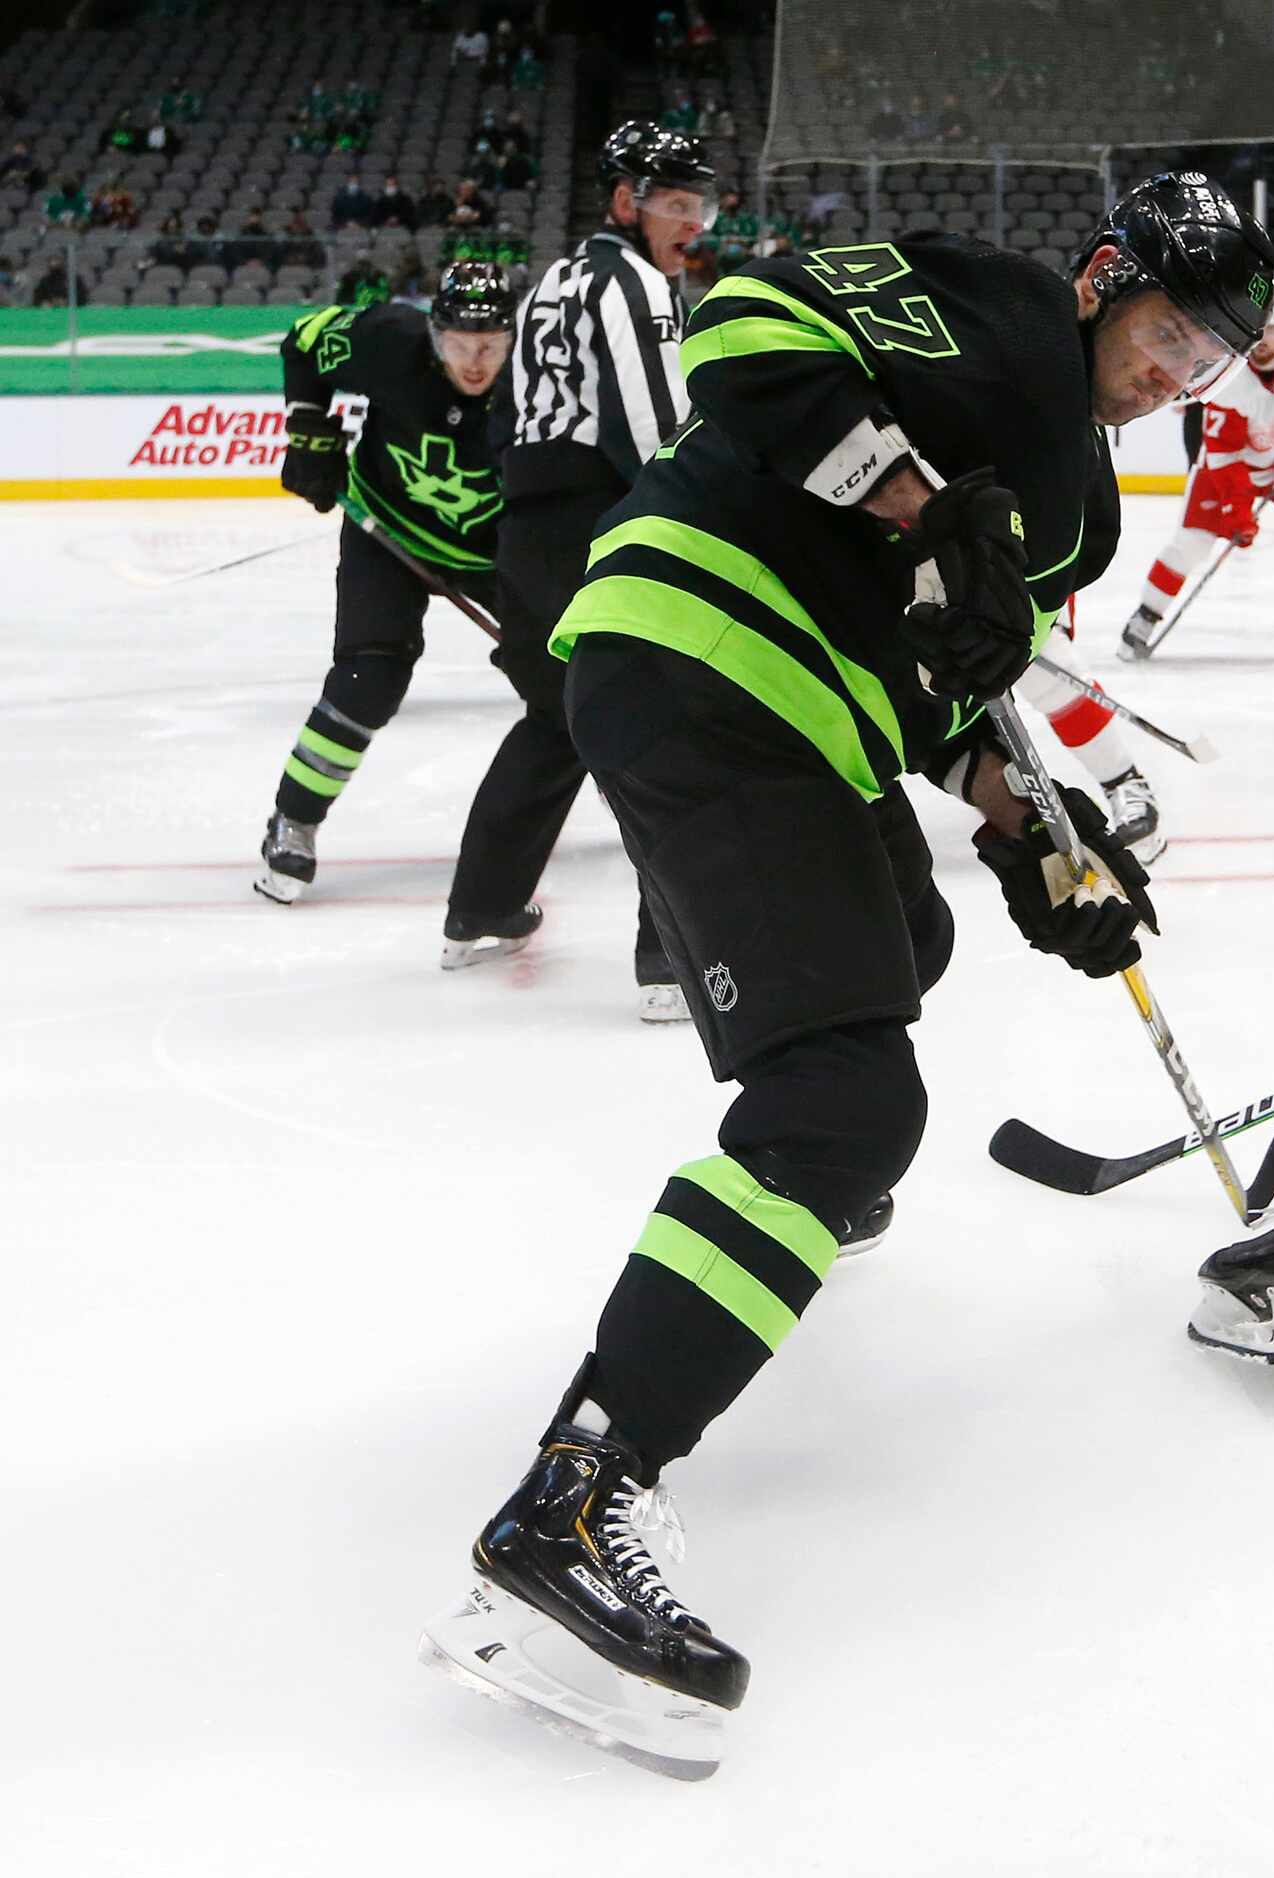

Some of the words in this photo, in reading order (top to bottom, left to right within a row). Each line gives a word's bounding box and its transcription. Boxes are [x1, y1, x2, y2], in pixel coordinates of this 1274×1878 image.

[801, 242, 961, 358] 47
[152, 403, 290, 436] Advan
[130, 440, 218, 465] Auto
[224, 440, 290, 465] Par
[831, 454, 878, 499] CCM
[1022, 772, 1057, 825] CCM
